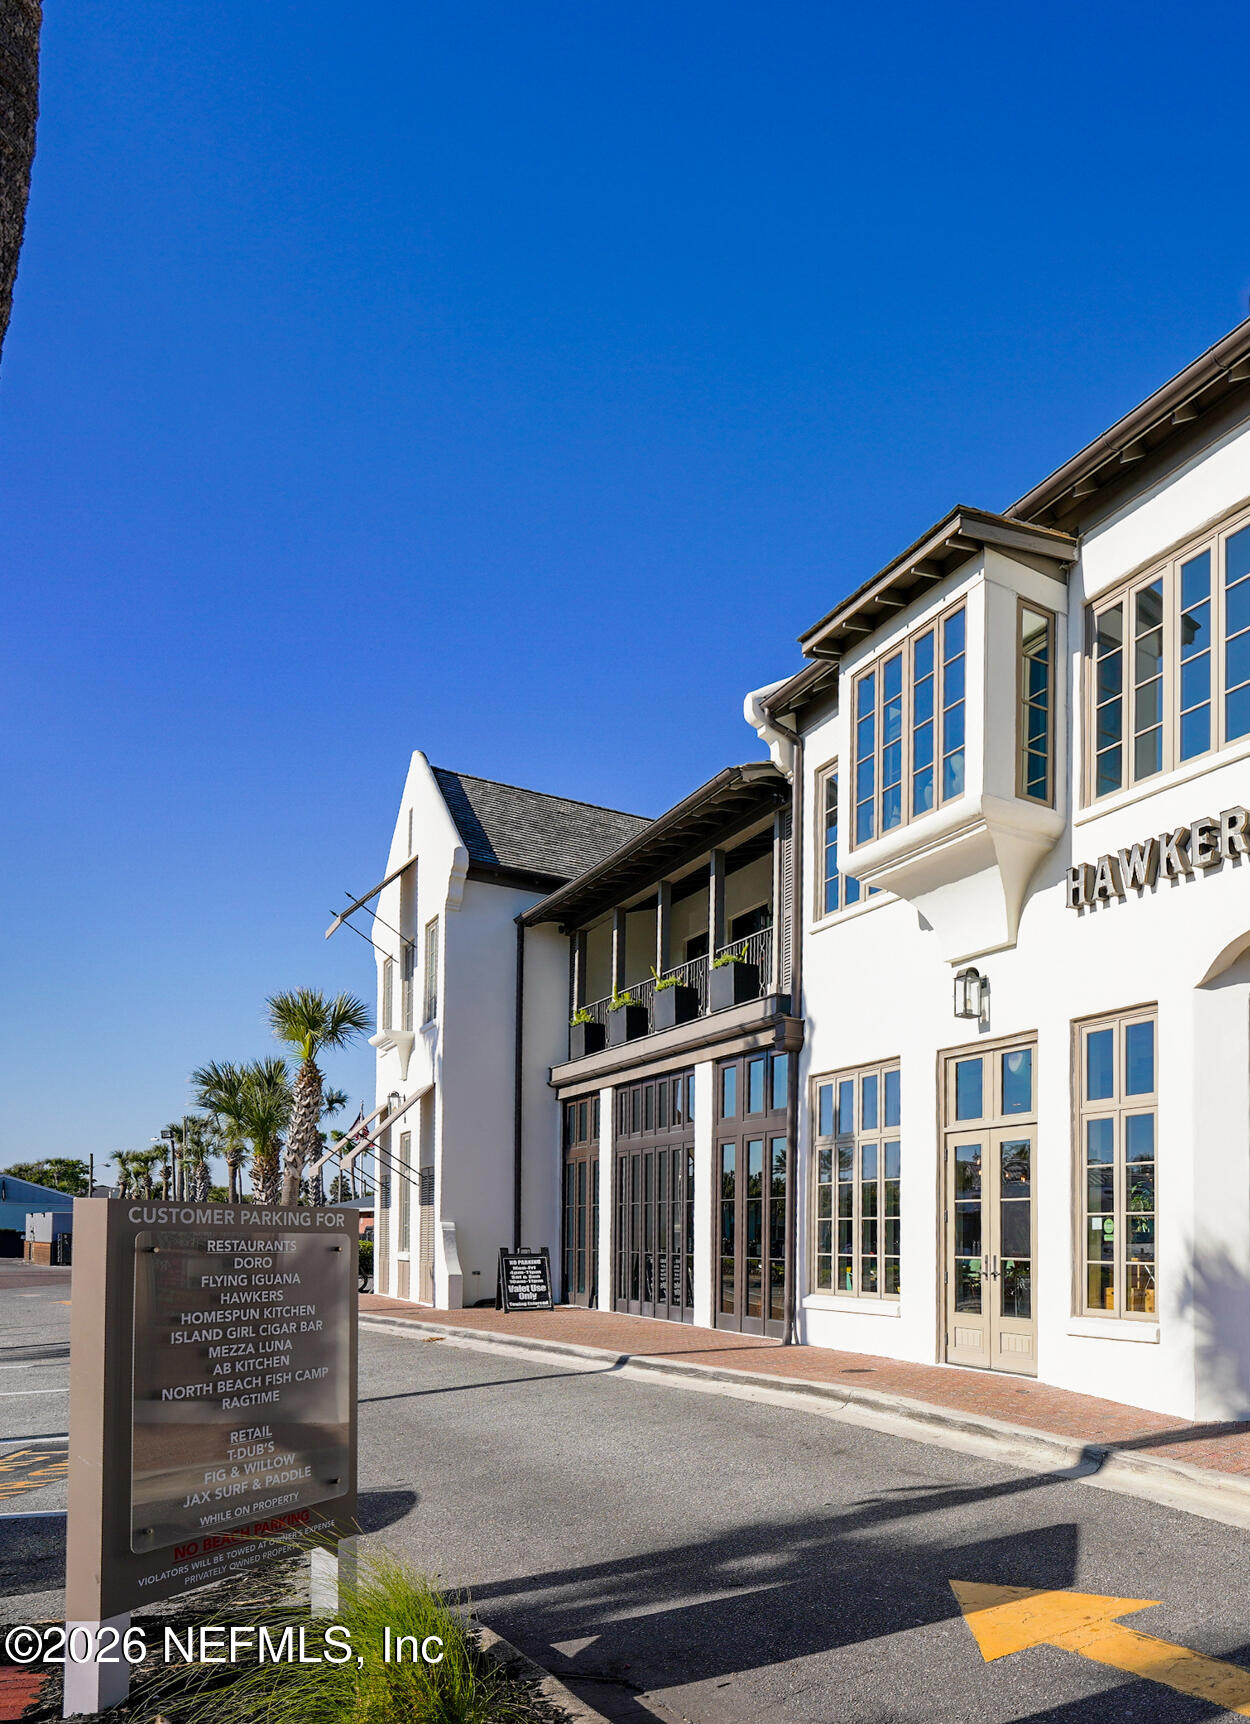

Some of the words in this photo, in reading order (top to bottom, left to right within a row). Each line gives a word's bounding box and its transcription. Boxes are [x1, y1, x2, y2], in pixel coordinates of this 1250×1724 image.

[128, 1206, 235, 1225] CUSTOMER
[240, 1210, 310, 1228] PARKING
[316, 1213, 345, 1228] FOR
[207, 1240, 297, 1253] RESTAURANTS
[234, 1257, 273, 1270] DORO
[201, 1275, 248, 1289] FLYING
[252, 1273, 301, 1286] IGUANA
[508, 1285, 530, 1293] Valet
[530, 1284, 546, 1292] Use
[220, 1290, 284, 1305] HAWKERS
[518, 1292, 537, 1300] Only
[181, 1308, 260, 1325] HOMESPUN
[263, 1304, 316, 1319] KITCHEN
[170, 1328, 223, 1345] ISLAND
[226, 1326, 256, 1340] GIRL
[259, 1322, 297, 1337] CIGAR
[300, 1320, 323, 1333] BAR
[208, 1344, 255, 1359] MEZZA
[259, 1339, 293, 1354] LUNA
[212, 1363, 232, 1376] AB
[235, 1355, 290, 1373] KITCHEN
[162, 1382, 213, 1401] NORTH
[217, 1376, 262, 1394] BEACH
[265, 1372, 292, 1386] FISH
[295, 1367, 329, 1382] CAMP
[222, 1390, 280, 1410] RAGTIME
[230, 1425, 272, 1444] RETAIL
[227, 1441, 275, 1461] T-DUB'S
[204, 1469, 227, 1485] FIG
[230, 1466, 240, 1479] &
[243, 1452, 296, 1473] WILLOW
[183, 1491, 211, 1509] JAX
[215, 1482, 248, 1500] SURF
[253, 1479, 262, 1491] &
[265, 1465, 312, 1487] PADDLE
[199, 1509, 232, 1527] WHILE
[234, 1505, 250, 1518] ON
[253, 1491, 300, 1514] PROPERTY
[174, 1541, 199, 1560] NO
[203, 1526, 251, 1551] BEACH
[254, 1508, 310, 1536] PARKING
[138, 1564, 189, 1588] VIOLATORS
[191, 1555, 212, 1570] WILL
[213, 1551, 225, 1563] BE
[226, 1543, 256, 1560] TOWED
[257, 1539, 268, 1551] AT
[304, 1519, 336, 1536] EXPENSE
[184, 1564, 228, 1586] PRIVATELY
[229, 1553, 261, 1572] OWNED
